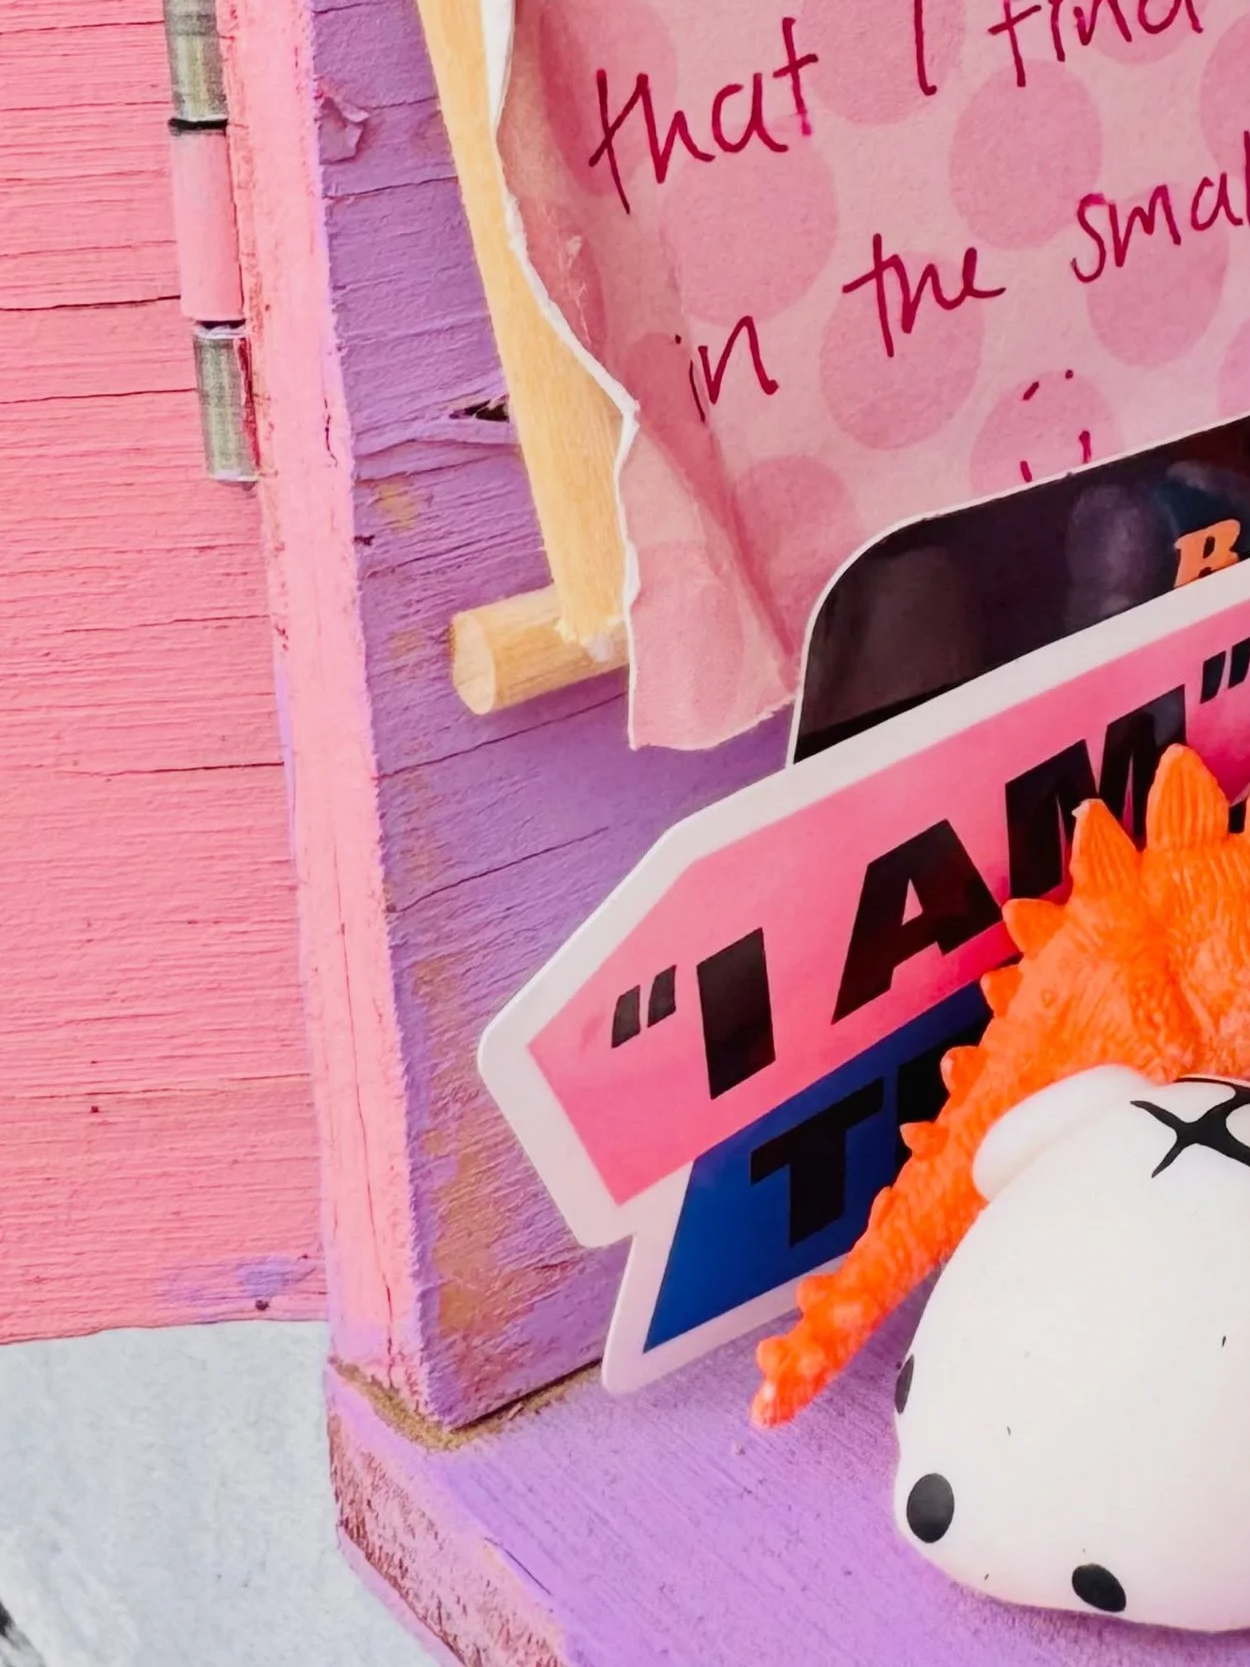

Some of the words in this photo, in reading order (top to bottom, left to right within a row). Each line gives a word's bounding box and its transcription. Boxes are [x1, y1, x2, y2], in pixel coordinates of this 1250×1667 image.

[589, 17, 820, 214] that
[674, 315, 780, 423] in
[842, 232, 1006, 358] the
